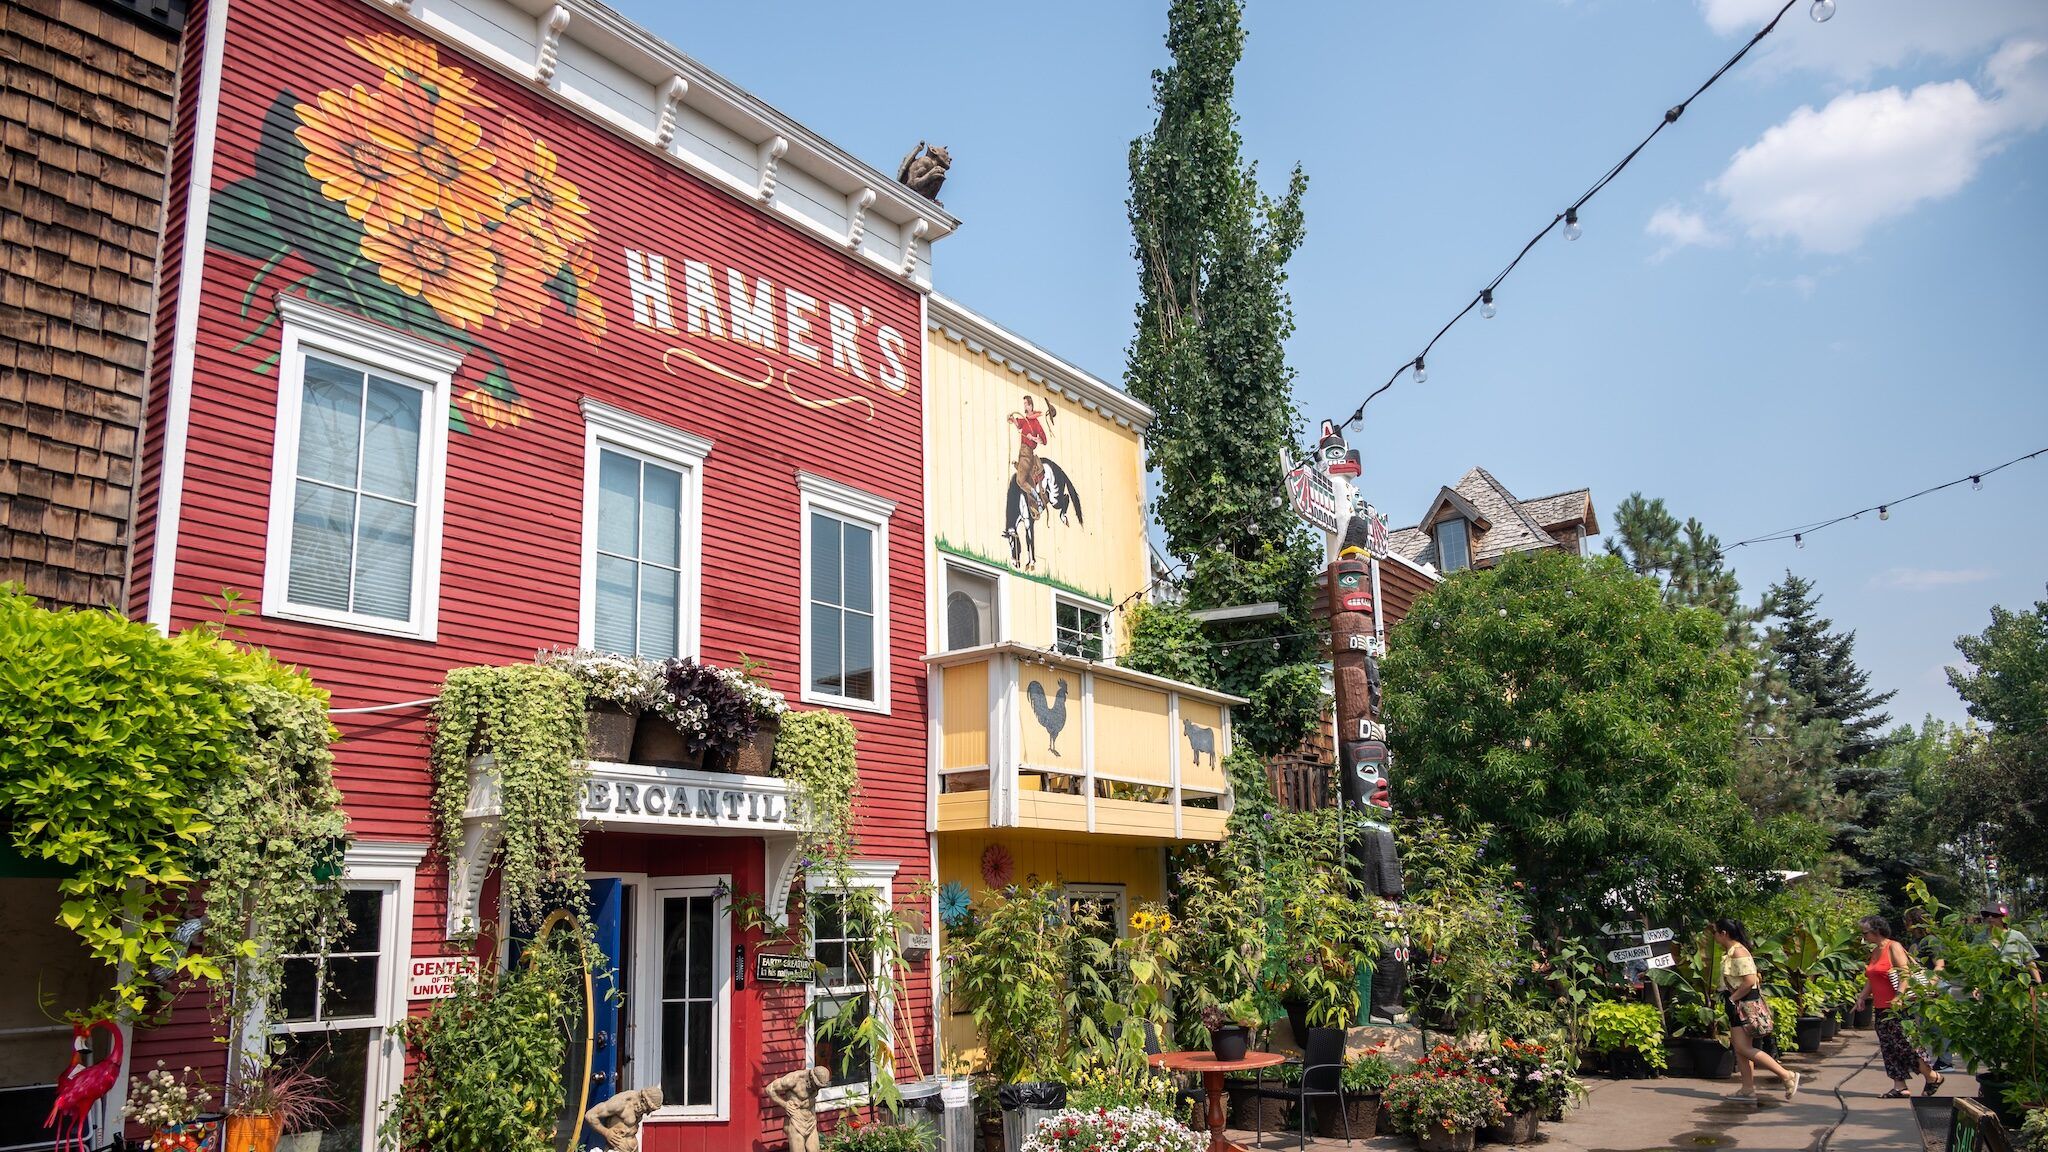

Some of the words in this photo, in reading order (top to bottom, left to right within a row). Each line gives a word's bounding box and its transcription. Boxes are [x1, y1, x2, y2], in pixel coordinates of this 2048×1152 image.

[624, 247, 910, 397] HAMER'S
[579, 780, 801, 824] ERCANTILE
[413, 961, 476, 976] CENTER
[1613, 947, 1650, 961] RESTAURANT
